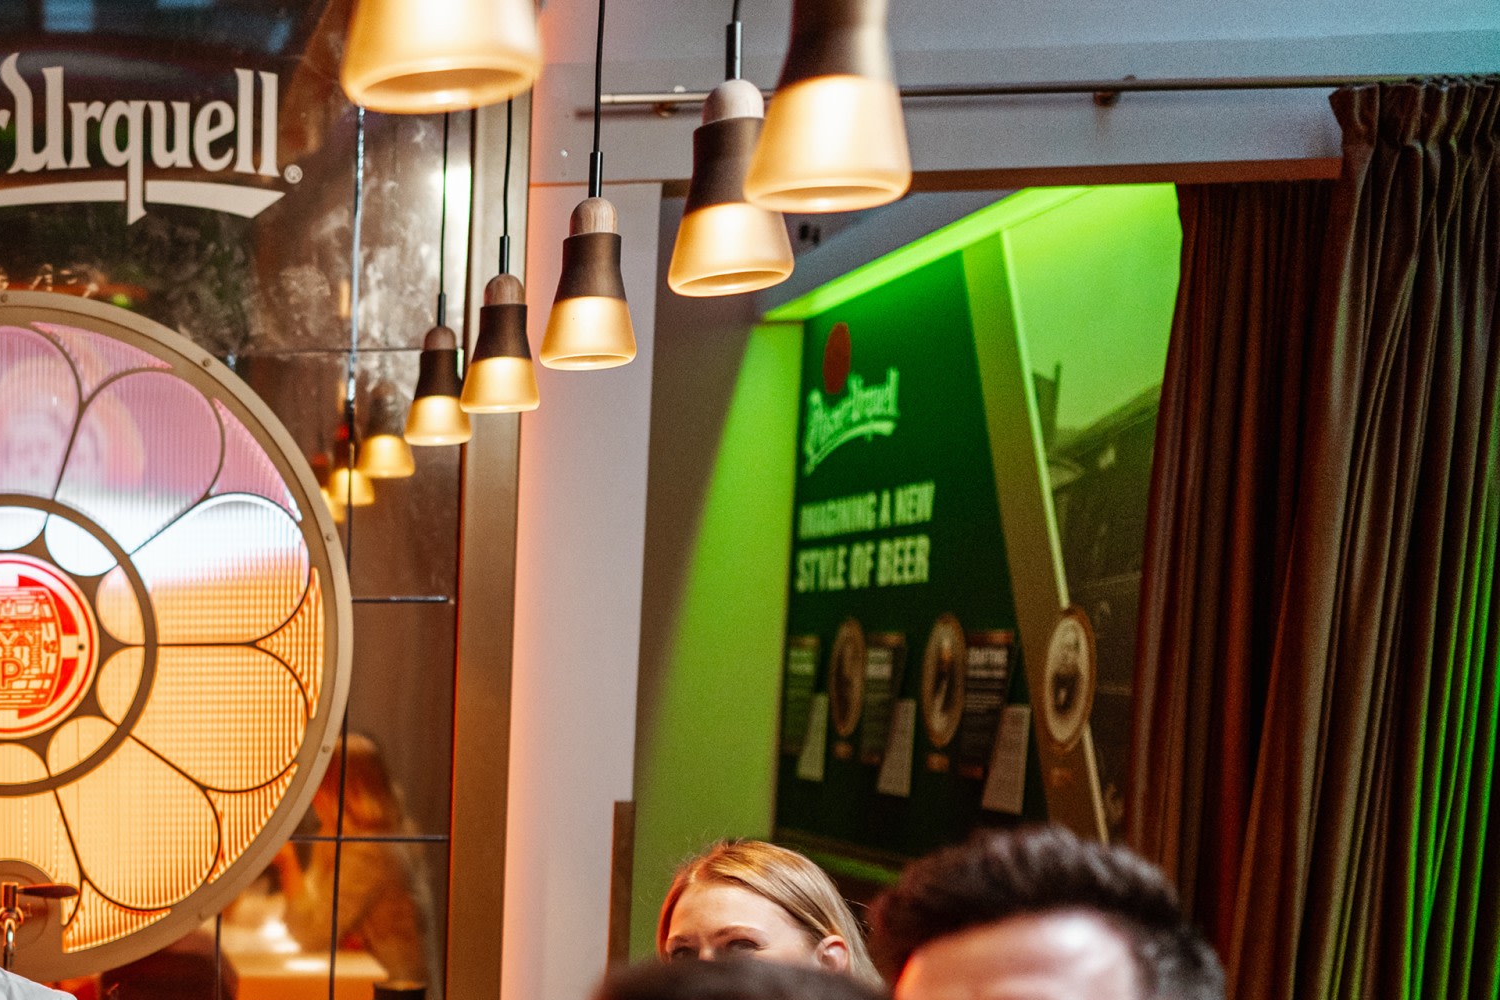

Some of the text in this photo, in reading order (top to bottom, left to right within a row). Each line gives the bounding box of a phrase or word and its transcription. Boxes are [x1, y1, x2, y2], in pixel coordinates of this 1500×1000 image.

[796, 534, 930, 593] STYLE OF BEER
[0, 659, 23, 688] P
